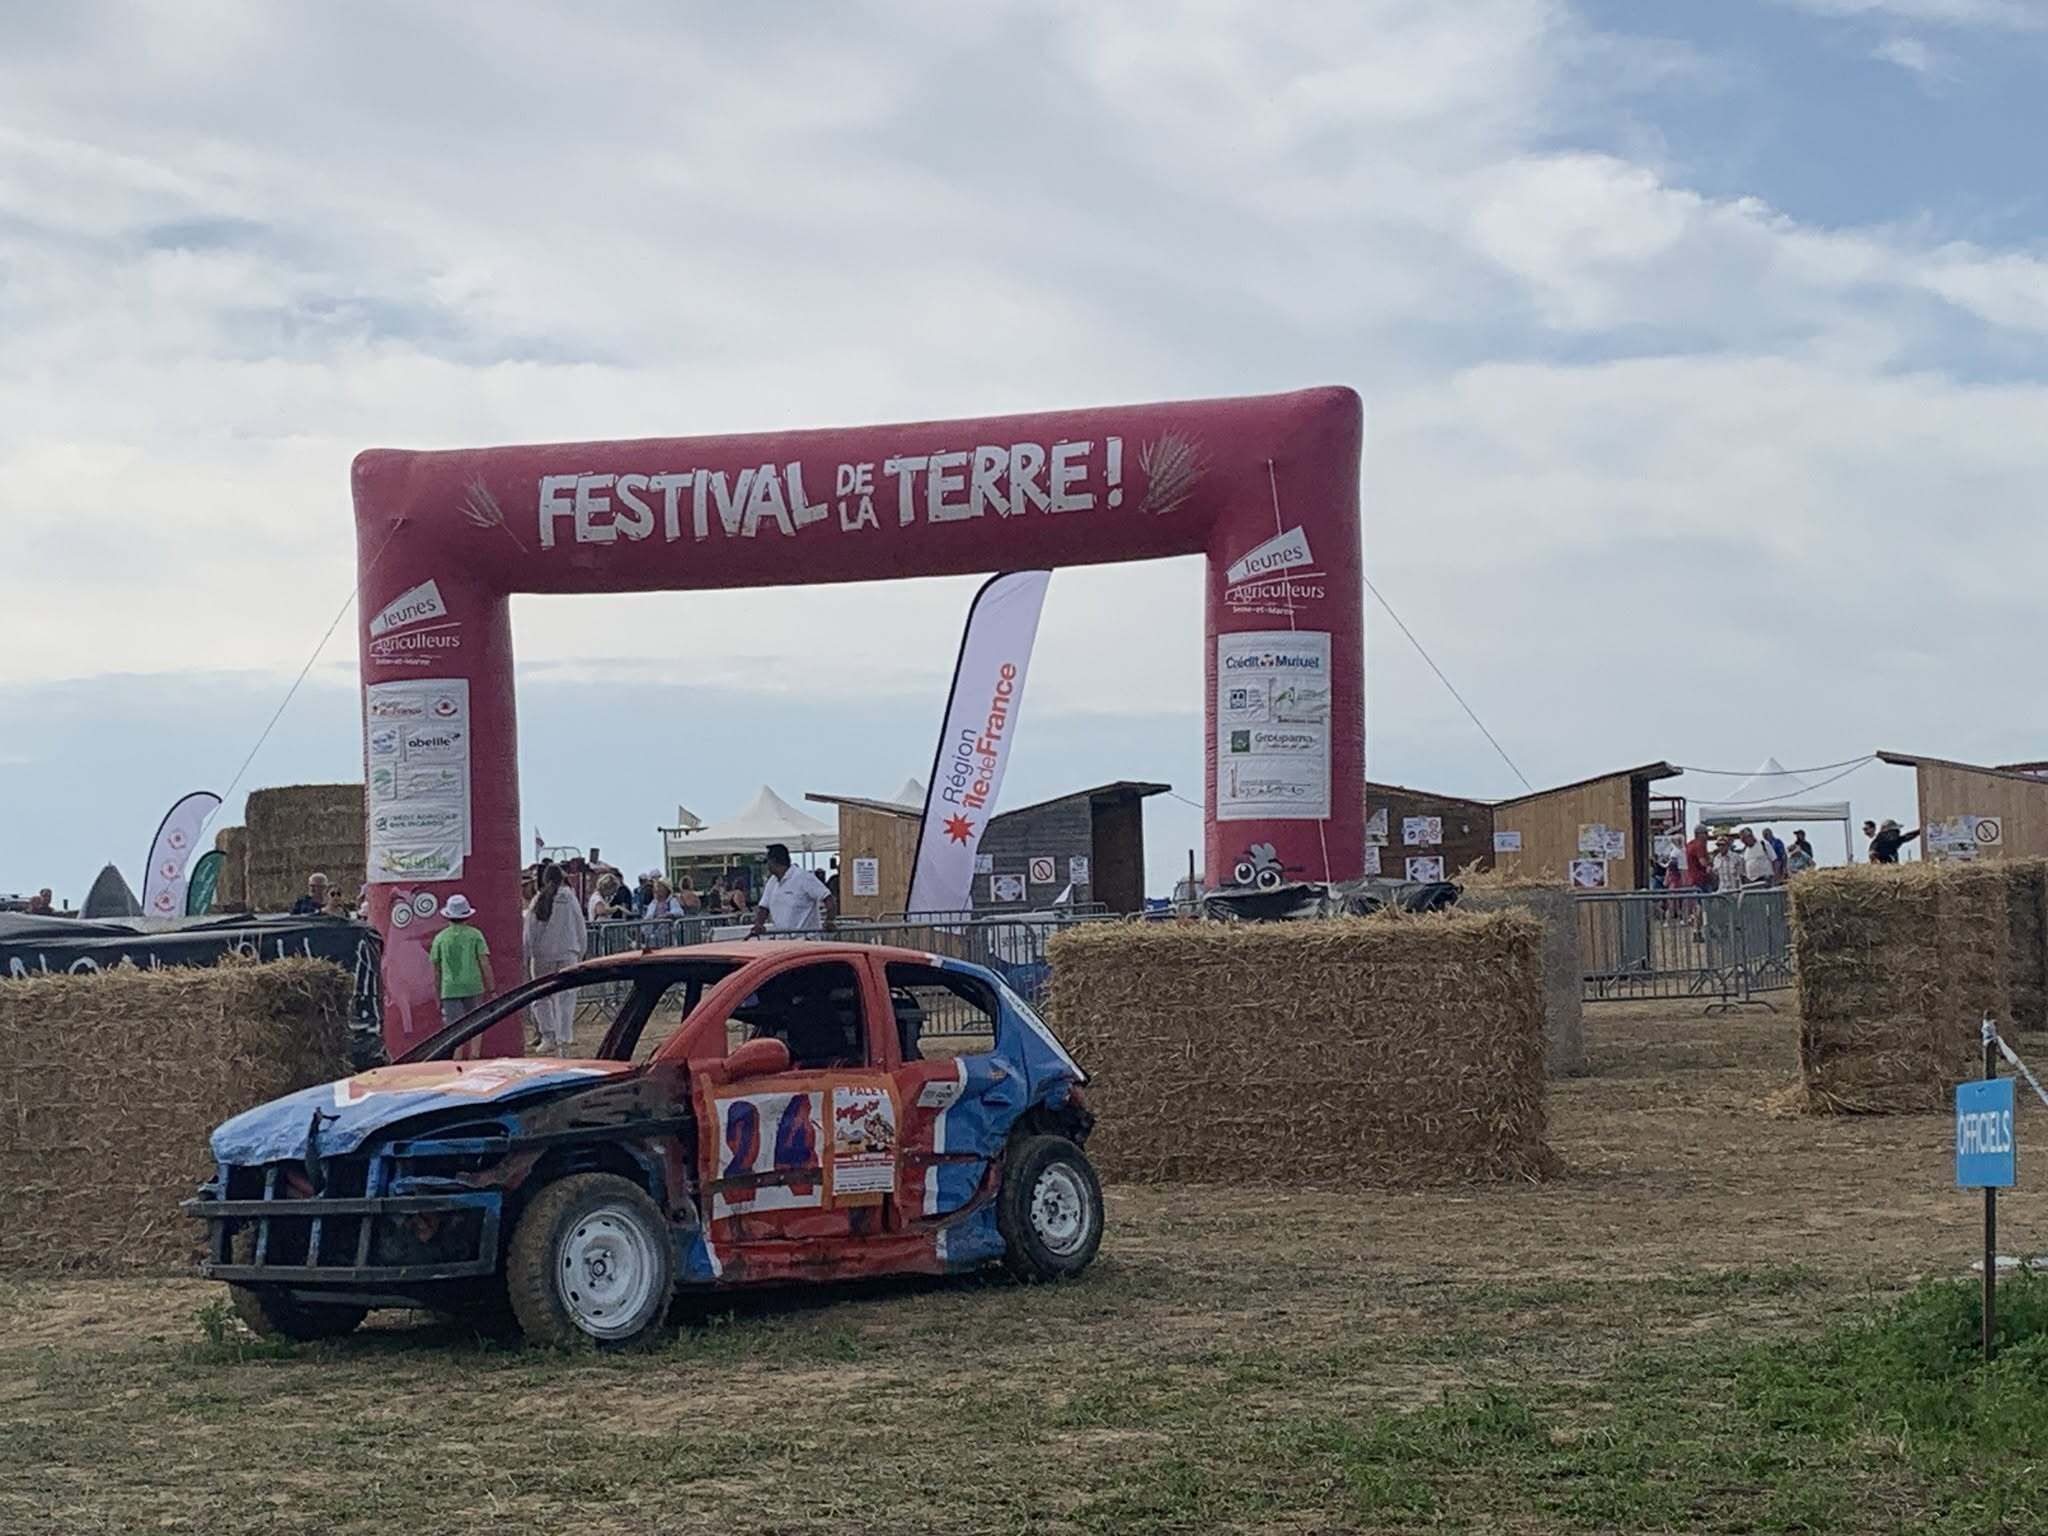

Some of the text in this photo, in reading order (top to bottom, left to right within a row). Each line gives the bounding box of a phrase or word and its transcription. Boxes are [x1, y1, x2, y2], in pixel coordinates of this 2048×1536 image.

[836, 462, 875, 496] DE
[539, 461, 828, 550] FESTIVAL
[838, 495, 880, 531] LA
[1243, 545, 1304, 576] Jeunes
[1233, 581, 1325, 603] Agriculteurs
[382, 598, 437, 628] Jeunes
[374, 632, 461, 656] Agriculteurs
[1226, 655, 1319, 669] Crédit Mutuel
[408, 737, 451, 748] abeille
[942, 728, 977, 805] Région
